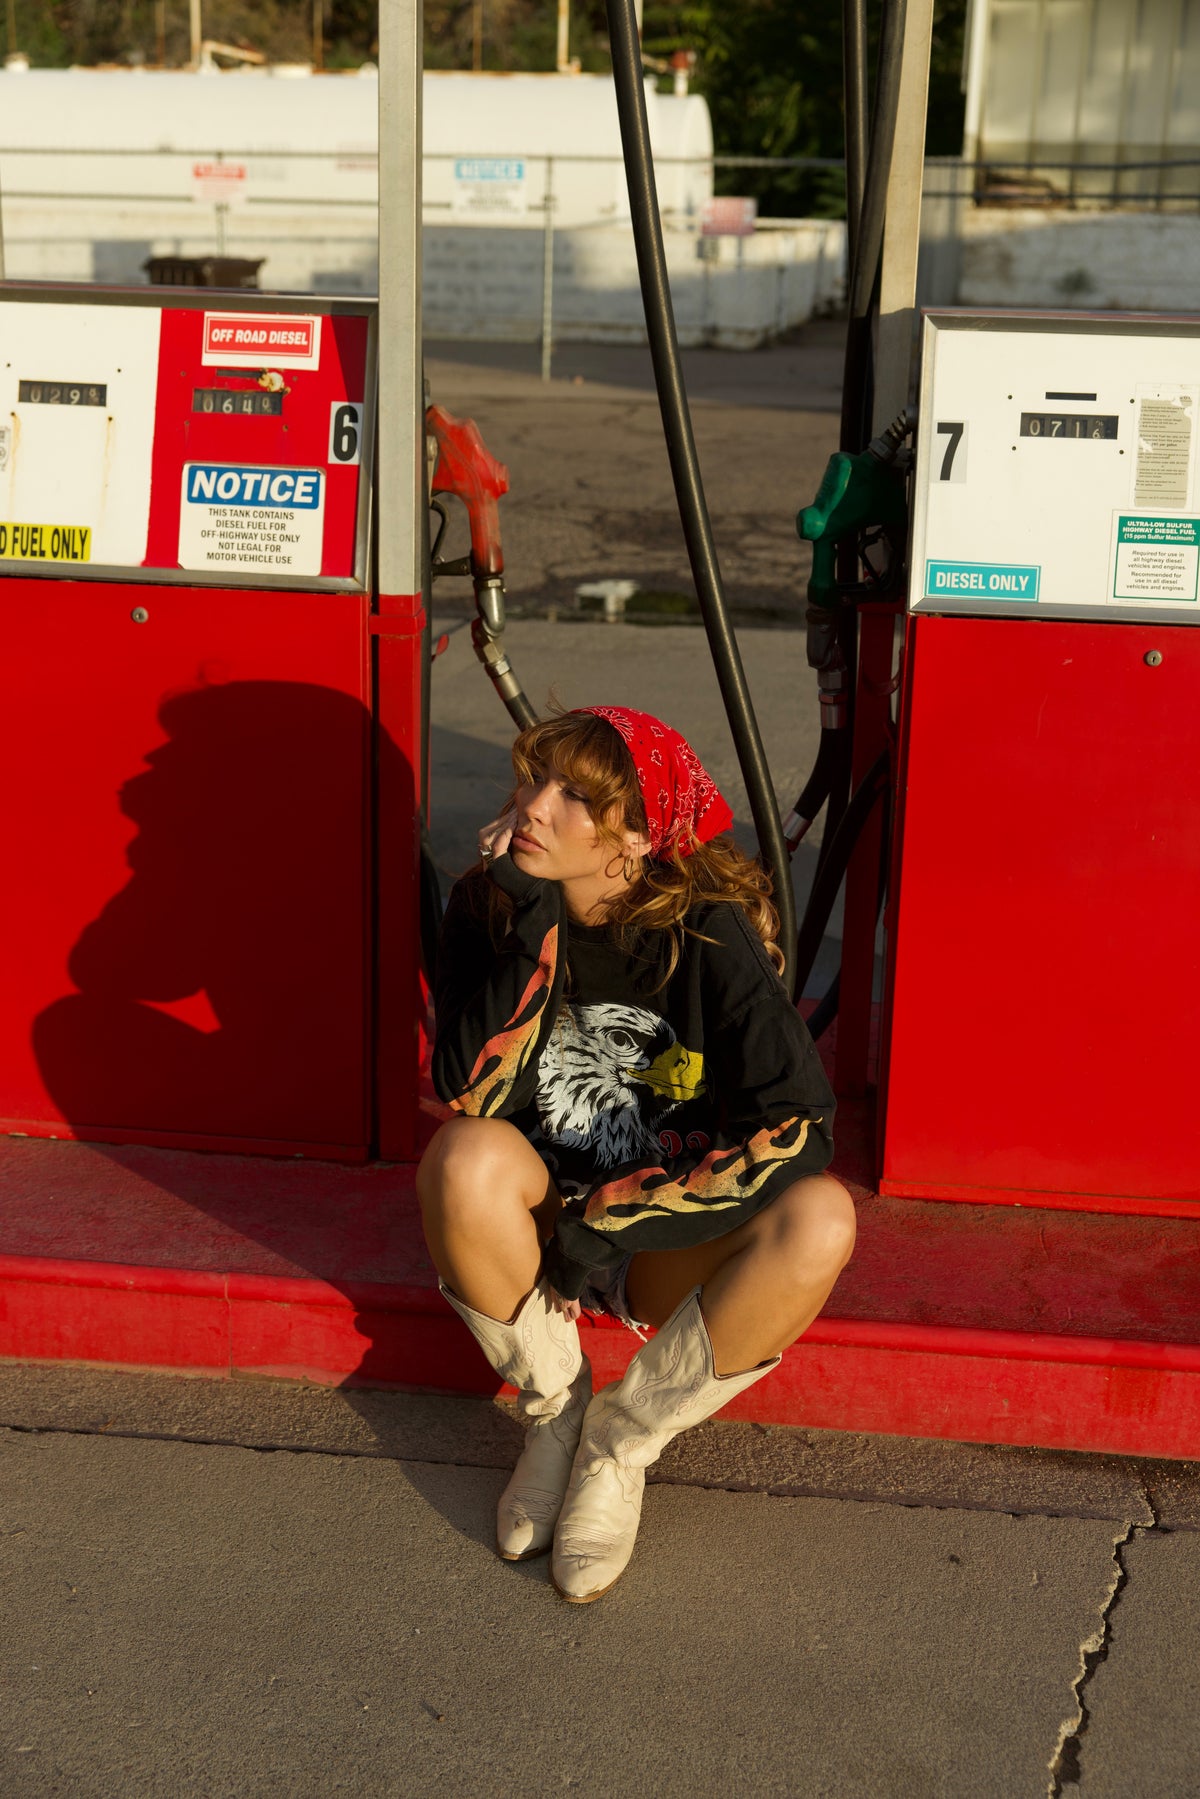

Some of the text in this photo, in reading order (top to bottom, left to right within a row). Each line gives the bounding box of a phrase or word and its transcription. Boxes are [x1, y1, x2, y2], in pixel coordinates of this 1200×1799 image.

[211, 328, 308, 346] OFF ROAD DIESEL
[332, 404, 358, 462] 6
[937, 422, 964, 481] 7
[191, 470, 318, 504] NOTICE
[208, 507, 295, 521] THIS TANK CONTAINS
[216, 520, 286, 531] DIESEL FUEL FOR
[12, 526, 46, 557] FUEL
[51, 528, 88, 559] ONLY
[201, 530, 301, 543] OFF-HIGHWAY USE ONLY
[218, 542, 281, 553] NOT LEGAL FOR
[207, 552, 293, 564] MOTOR VEHICLE USE
[936, 572, 1029, 591] DIESEL ONLY
